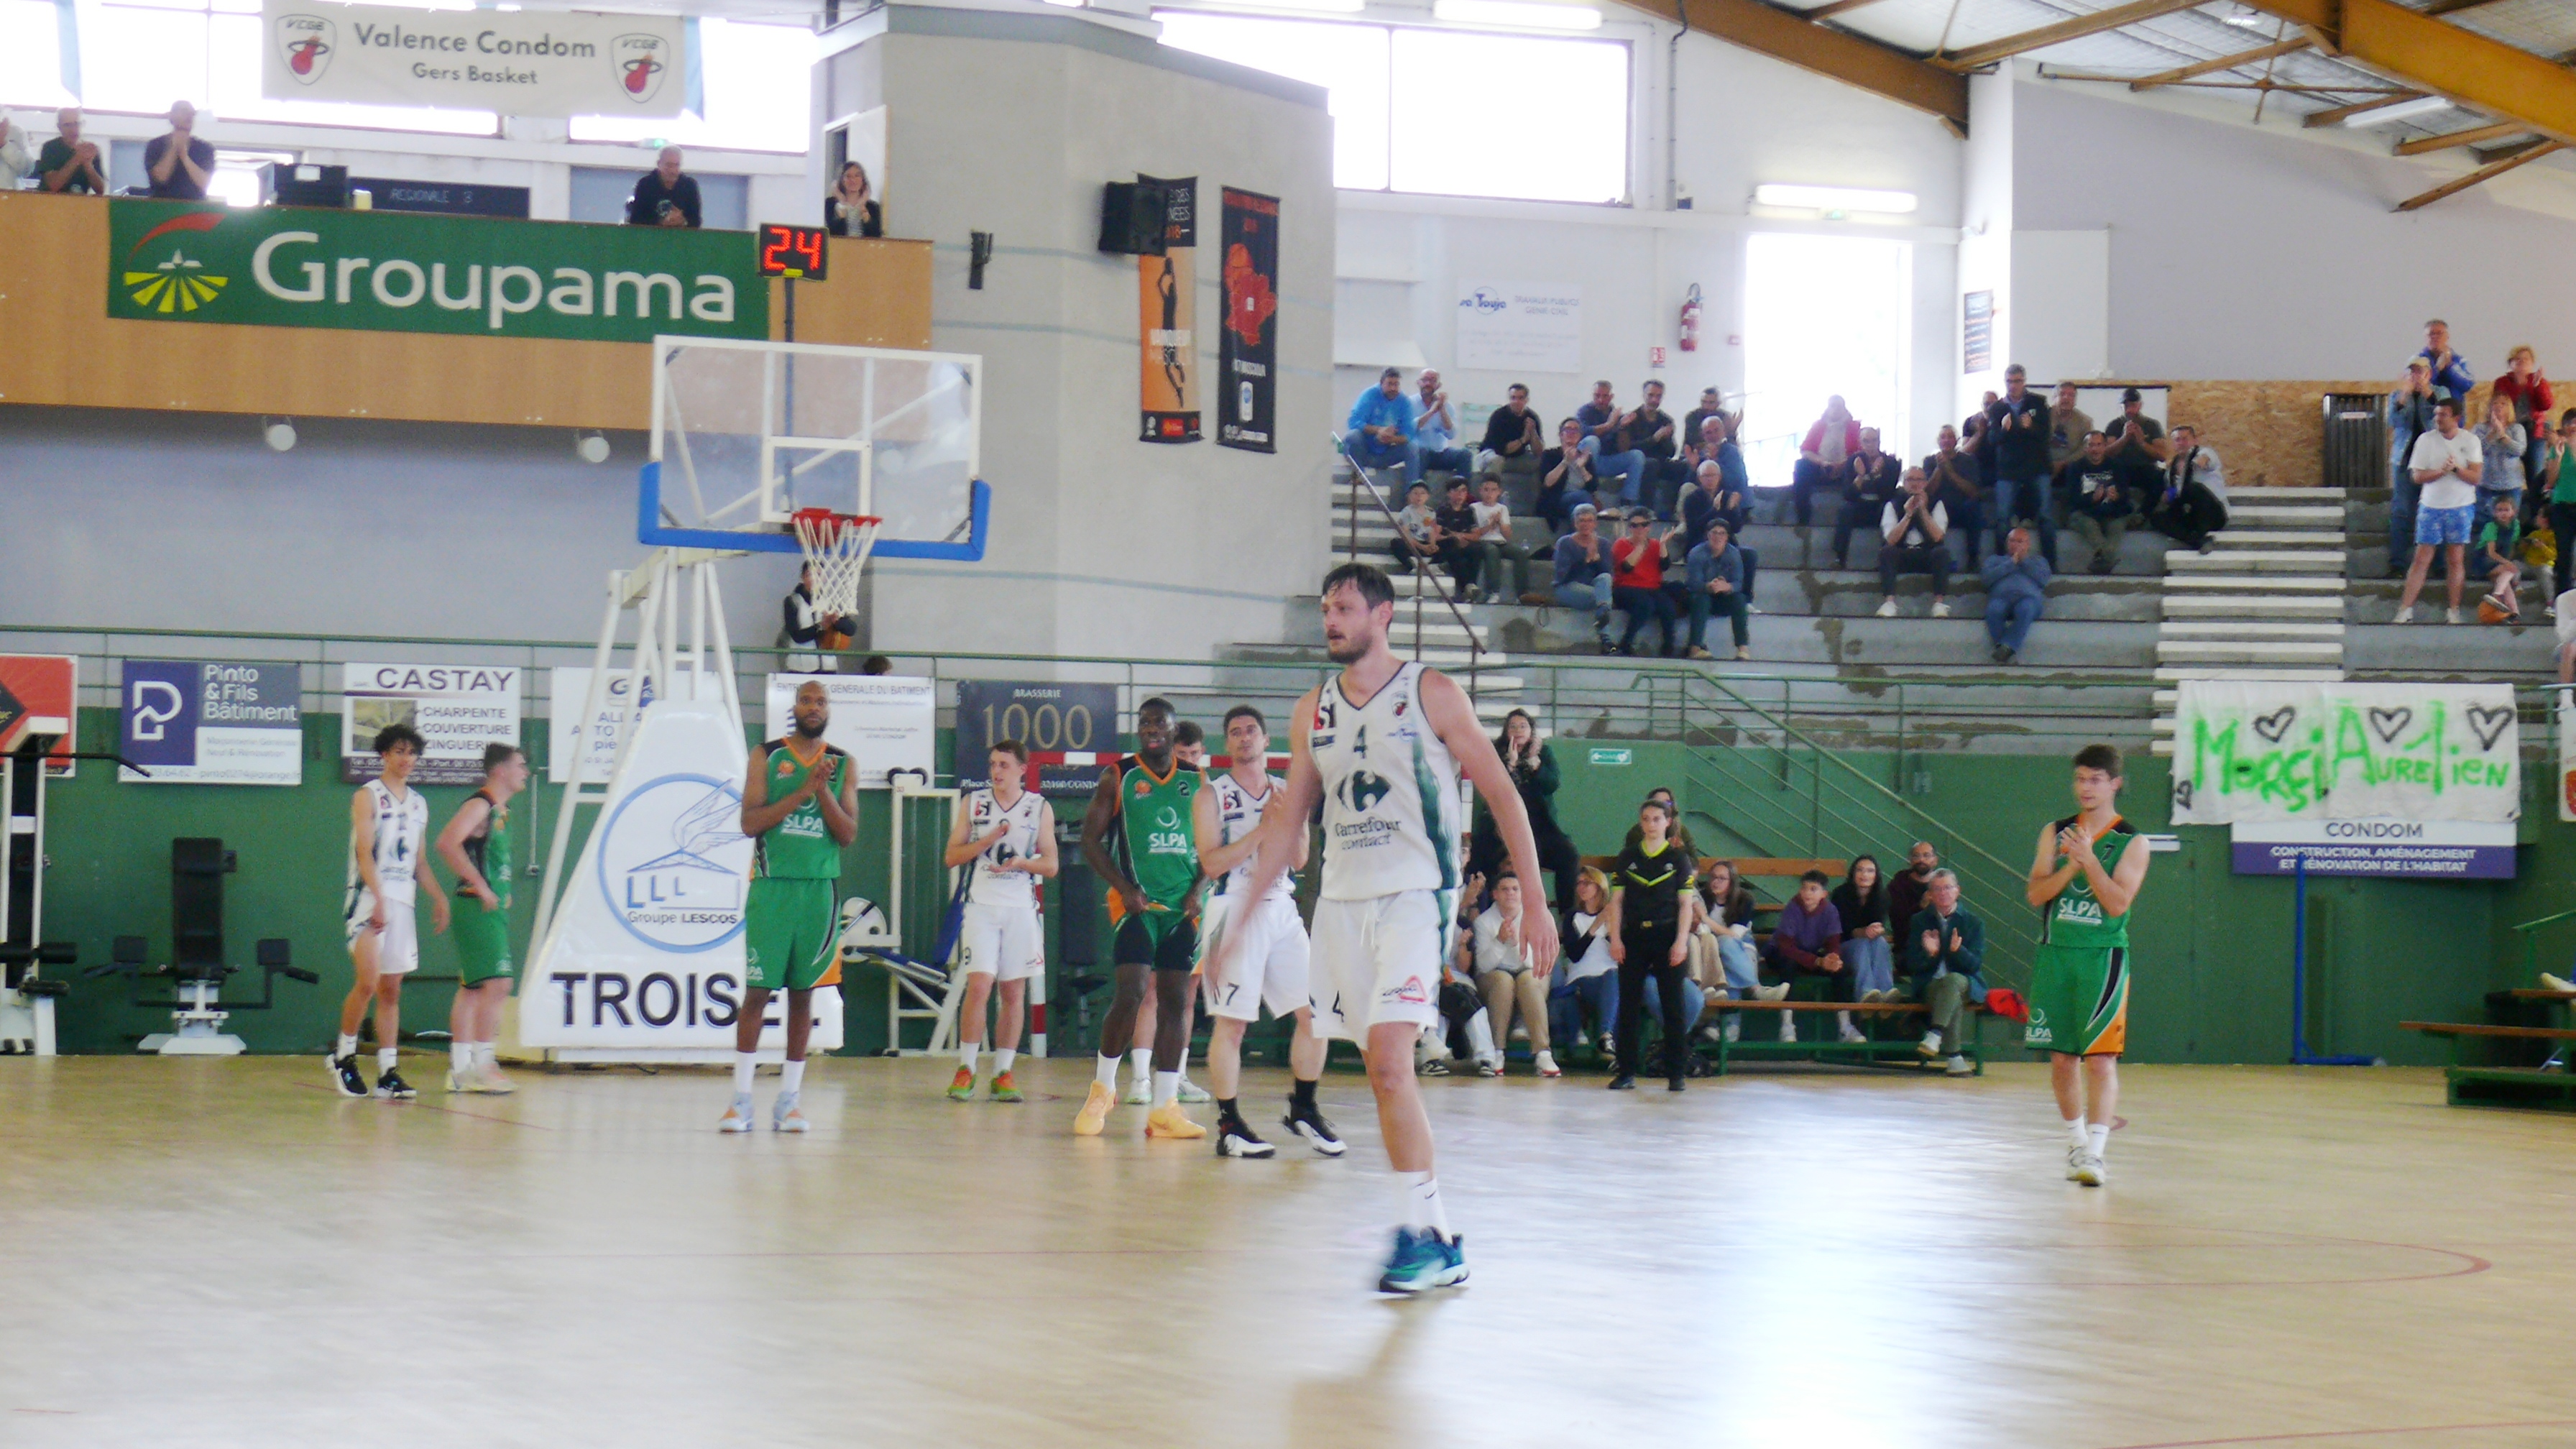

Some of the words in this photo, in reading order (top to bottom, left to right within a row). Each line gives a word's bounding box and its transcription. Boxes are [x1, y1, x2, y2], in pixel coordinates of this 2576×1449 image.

[354, 22, 467, 52] Valence
[477, 30, 596, 58] Condom
[412, 62, 461, 80] Gers
[468, 65, 538, 84] Basket
[764, 226, 822, 271] 24
[252, 231, 735, 329] Groupama
[203, 664, 259, 683] Pinto
[376, 668, 515, 691] CASTAY
[204, 683, 220, 701] &
[222, 684, 259, 702] Fils
[1013, 689, 1062, 699] BRASSERIE
[203, 702, 298, 722] Bâtiment
[423, 707, 507, 719] CHARPENTE
[423, 723, 512, 735] COUVERTURE
[983, 703, 1092, 750] 1000
[1353, 724, 1368, 760] 4
[1178, 781, 1190, 797] 2
[1335, 816, 1402, 837] Carrefour
[2325, 822, 2423, 838] CONDOM
[1149, 832, 1187, 847] SLPA
[2374, 845, 2476, 860] AMÉNAGEMENT
[2278, 859, 2297, 870] ET
[2383, 860, 2401, 871] DE
[2404, 861, 2467, 872] L'HABITAT
[627, 911, 678, 924] Groupe
[682, 912, 738, 924] LESCOS
[2058, 898, 2102, 918] SLPA
